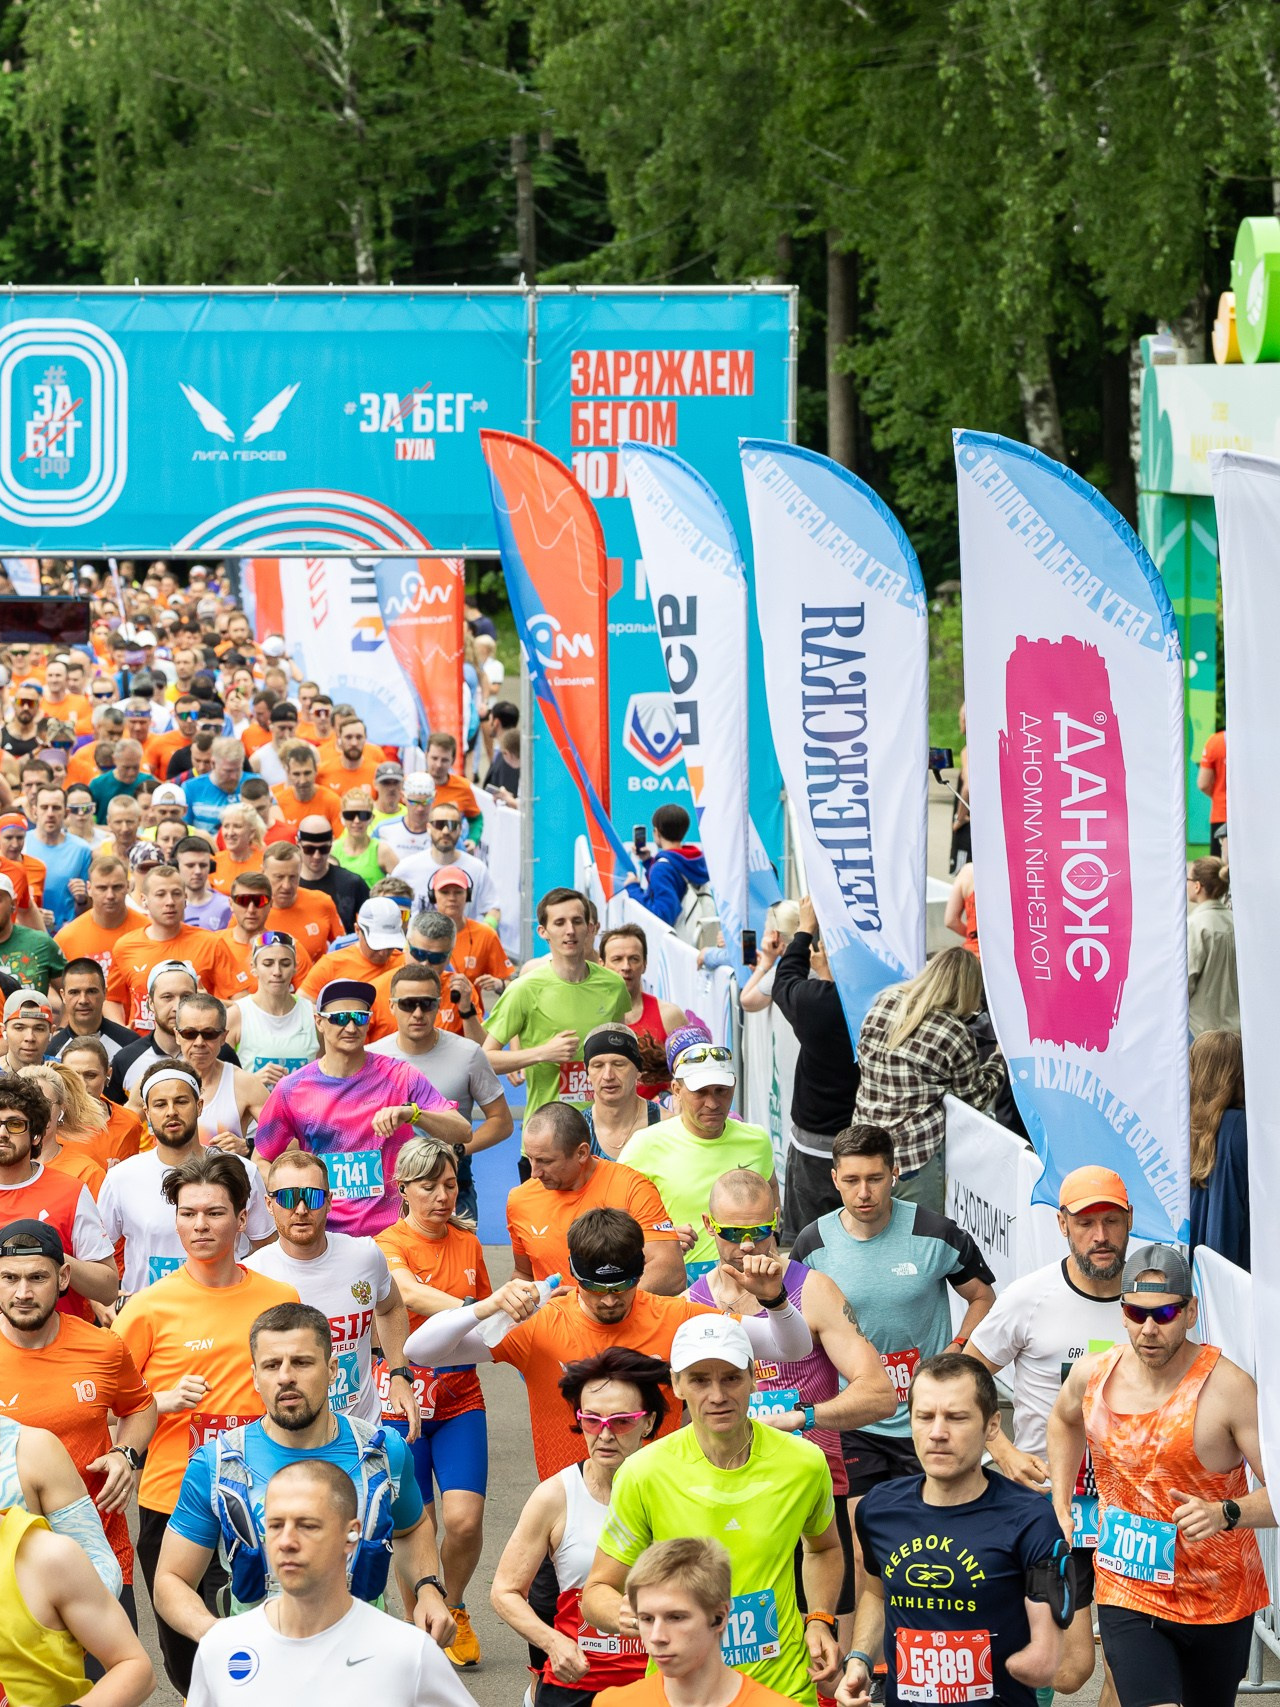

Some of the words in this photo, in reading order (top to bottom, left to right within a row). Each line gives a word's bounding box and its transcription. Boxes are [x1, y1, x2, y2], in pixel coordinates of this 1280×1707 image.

[571, 350, 754, 396] ЗАРЯЖАЕМ
[571, 402, 677, 447] БЕГОМ
[192, 450, 230, 461] ЛИГА
[233, 450, 287, 461] ГЕРОЕВ
[395, 438, 435, 461] ТУЛА
[572, 452, 609, 498] 10
[628, 776, 690, 792] ВФЛА
[333, 1161, 368, 1186] 7141
[72, 1379, 97, 1403] 10
[226, 1416, 238, 1428] 10
[1130, 1514, 1142, 1529] 10
[1113, 1524, 1157, 1566] 7071
[885, 1534, 953, 1578] REEBOK
[957, 1548, 986, 1589] INT.
[890, 1595, 977, 1612] ATHLETICS
[723, 1610, 758, 1648] 112
[931, 1631, 947, 1647] 10
[608, 1640, 616, 1651] B
[910, 1648, 975, 1684] 5389
